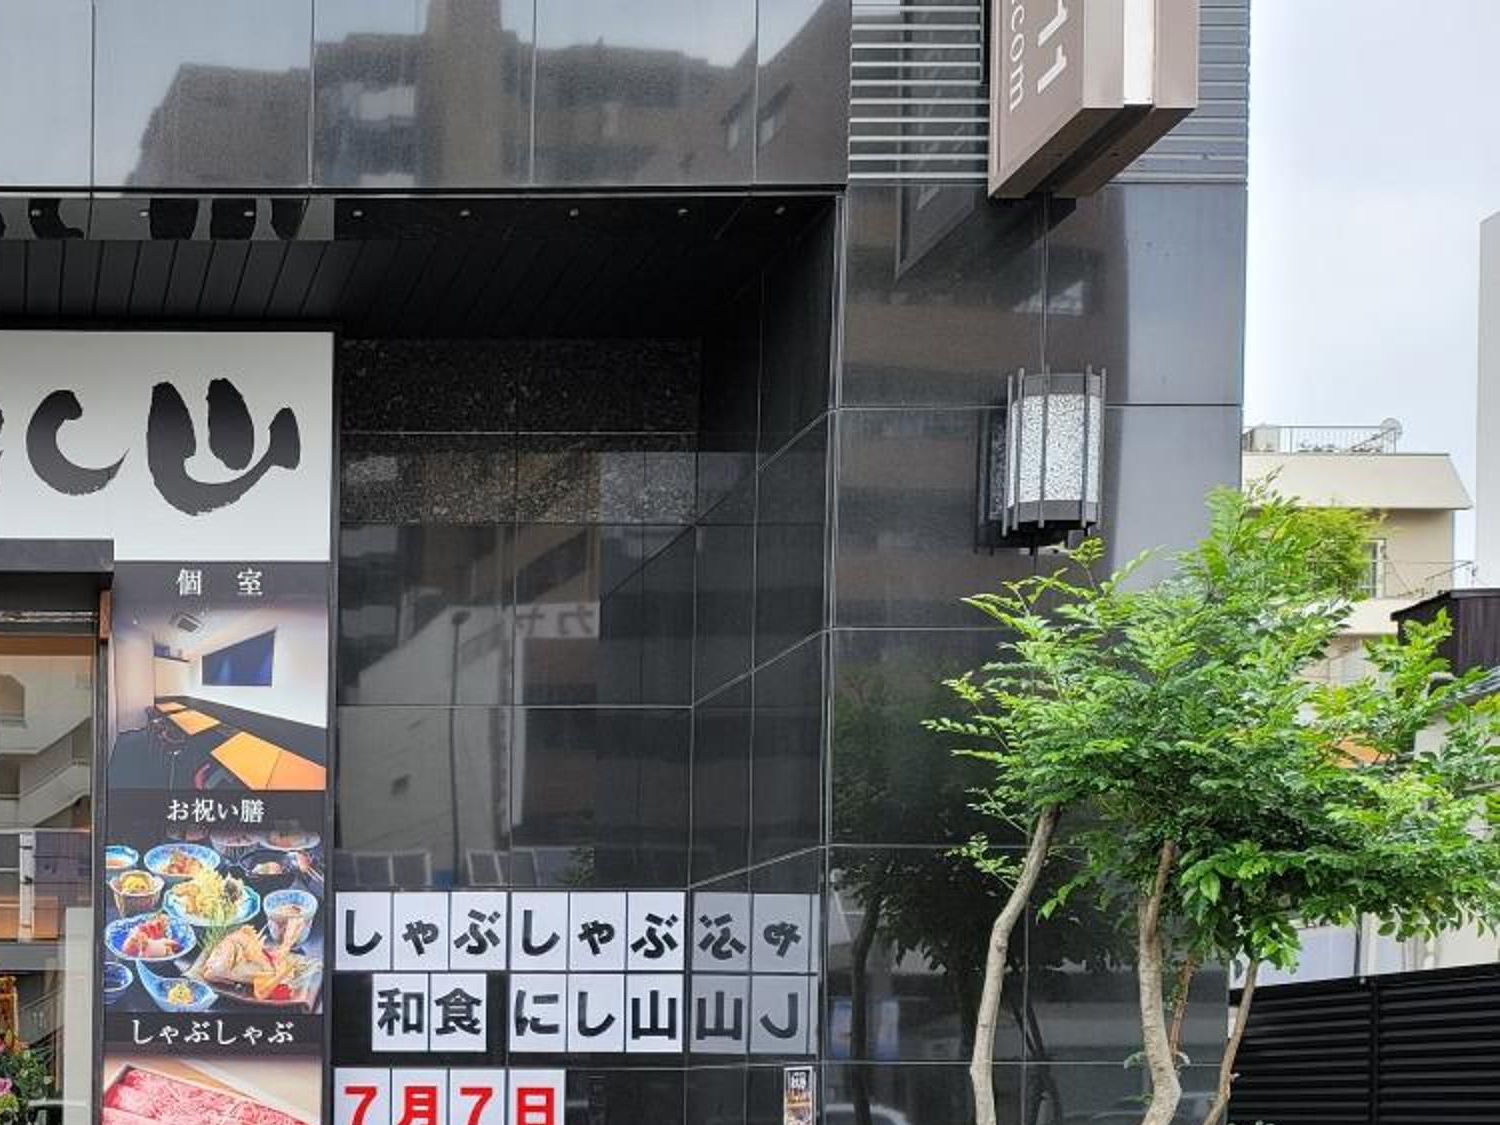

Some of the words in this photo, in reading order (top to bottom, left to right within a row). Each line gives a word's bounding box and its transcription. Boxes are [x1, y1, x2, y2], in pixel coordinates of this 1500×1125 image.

[176, 568, 263, 595] 個室
[166, 798, 265, 824] お祝い膳
[344, 908, 679, 959] しゃぶしゃぶ
[376, 986, 483, 1037] 和食
[514, 988, 678, 1041] にし山
[131, 1019, 295, 1045] しゃぶしゃぶ
